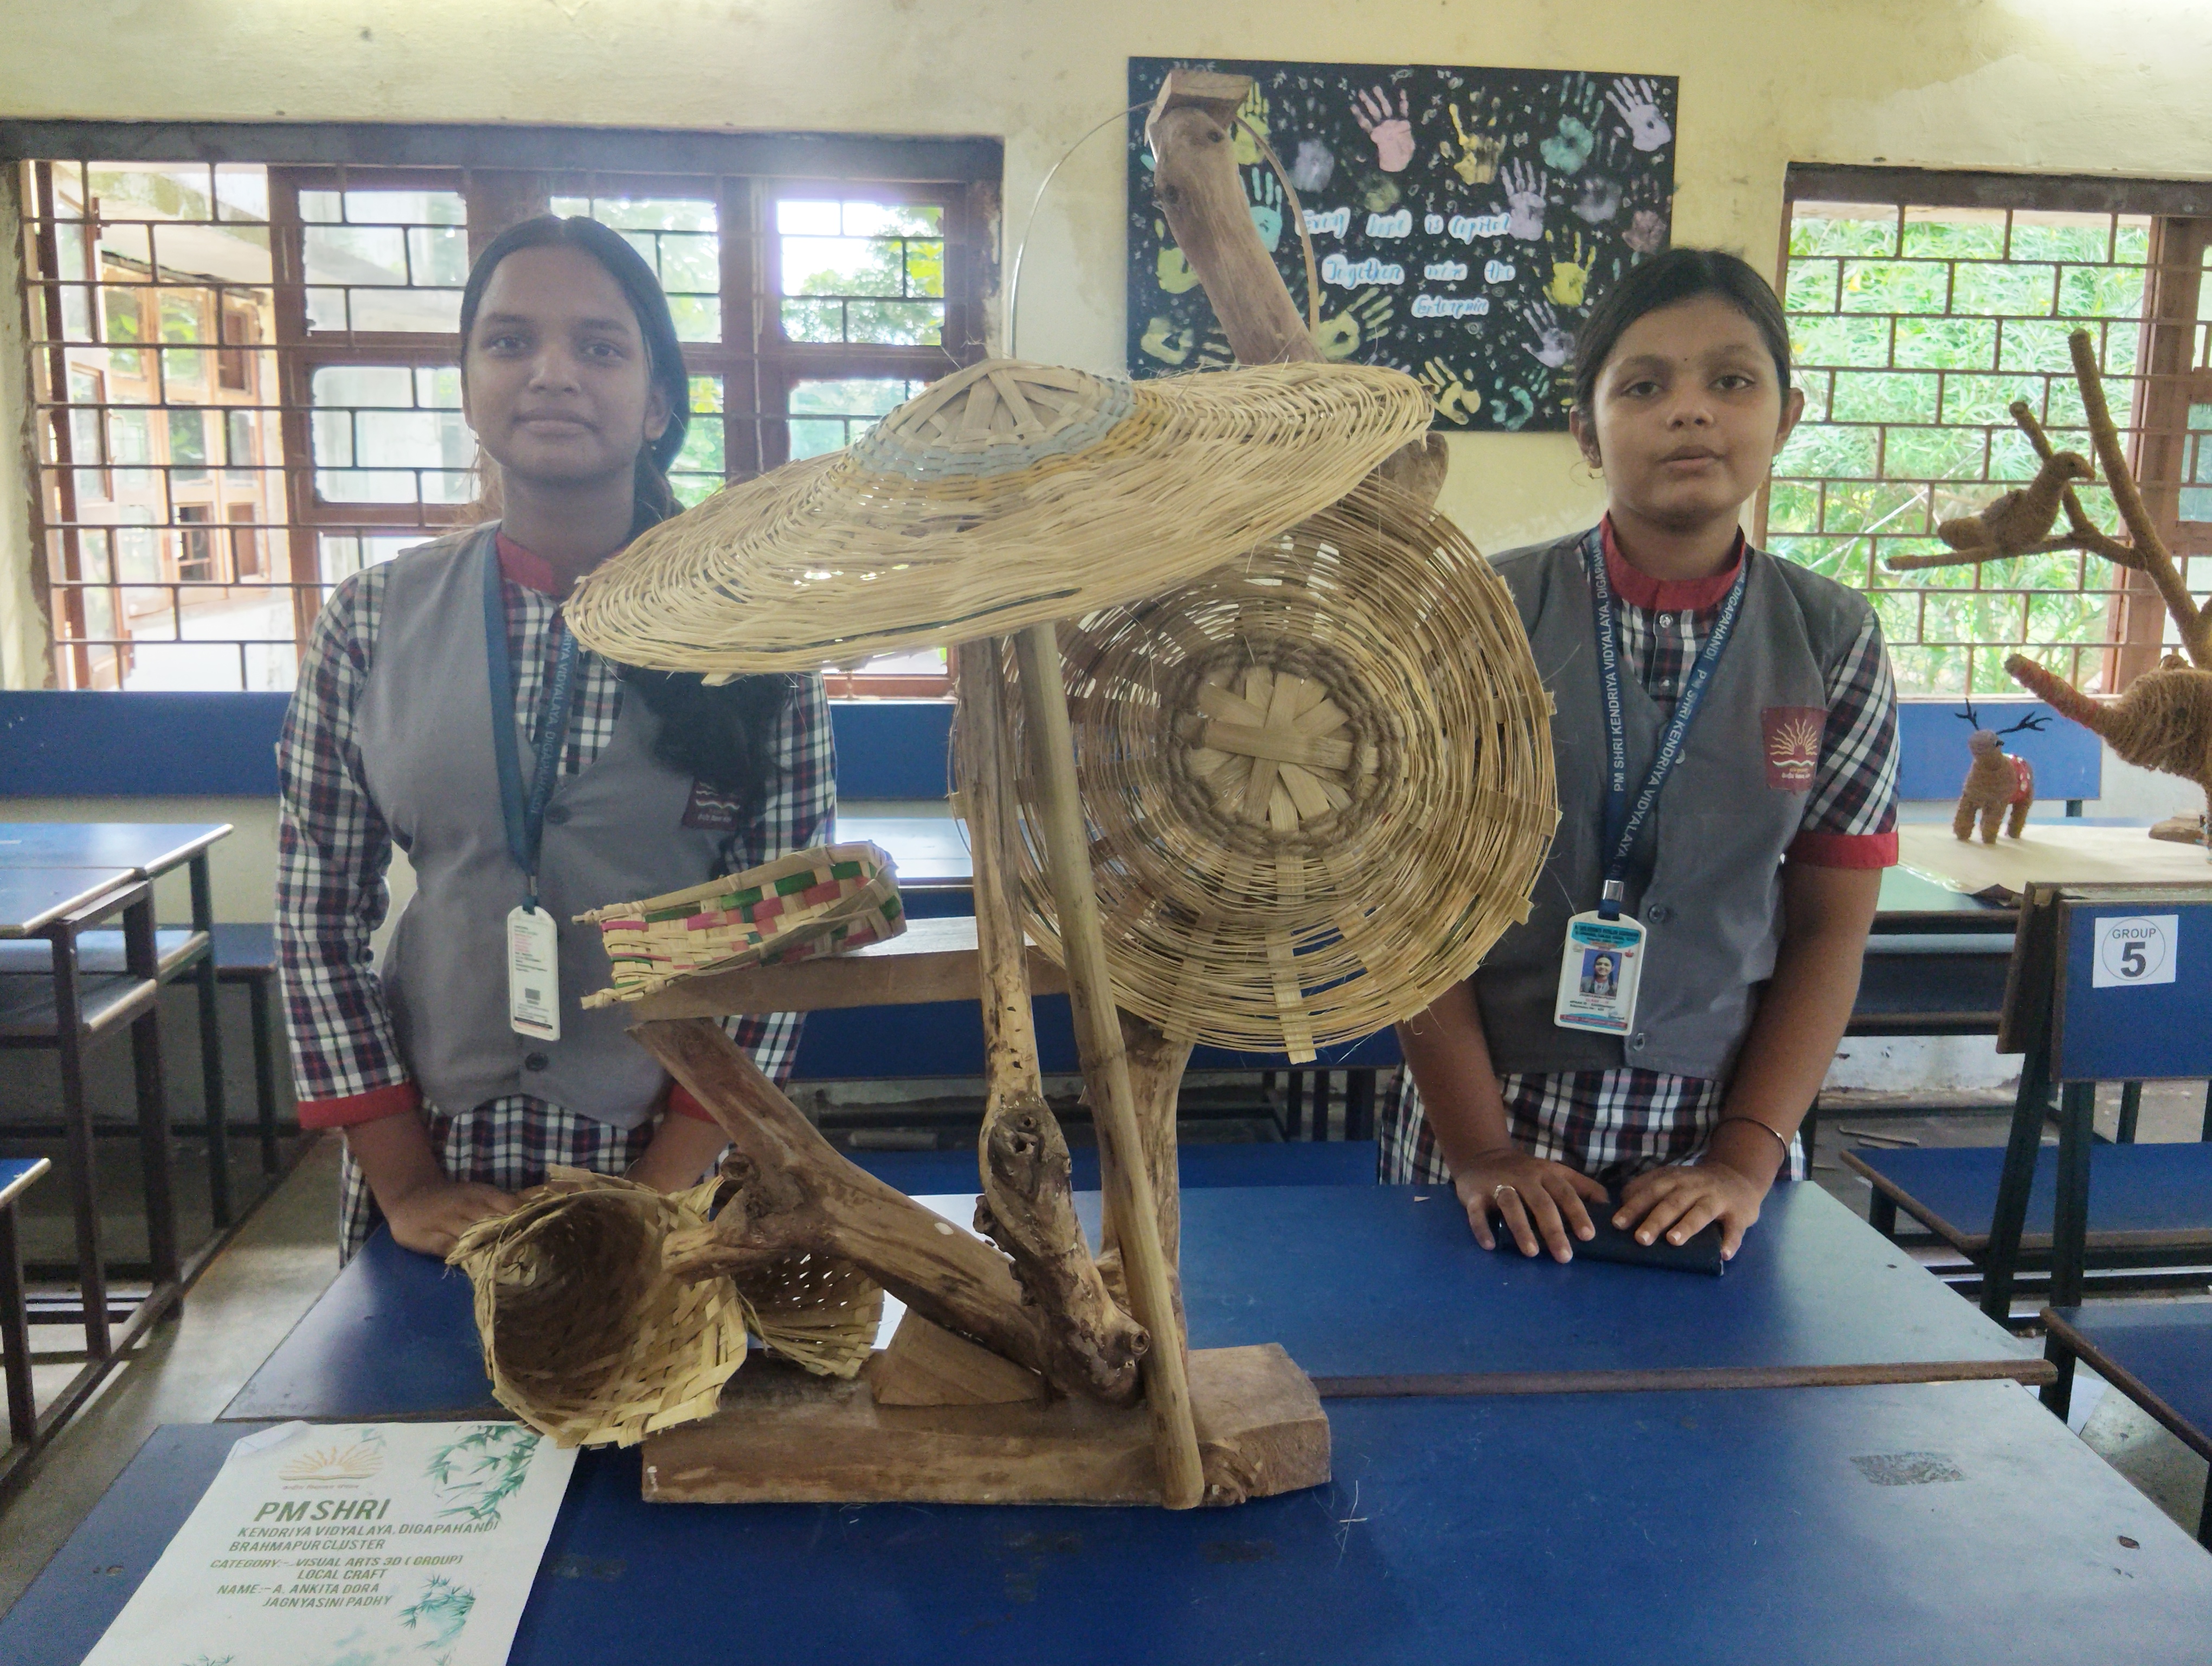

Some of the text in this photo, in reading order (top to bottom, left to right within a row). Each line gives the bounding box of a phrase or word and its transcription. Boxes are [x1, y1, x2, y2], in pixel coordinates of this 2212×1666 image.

[1425, 215, 1442, 234] is
[1324, 257, 1402, 289] Together
[1592, 534, 1608, 598] DIGAPAH
[1704, 586, 1741, 661] DIGAPAHANDI
[561, 627, 573, 661] DRIYA
[1605, 672, 1623, 735] KENDRIYA
[1679, 690, 1699, 720] SHRI
[1612, 738, 1624, 768] SHRI
[1648, 720, 1686, 785] KENDRIYA
[1613, 773, 1624, 792] PM
[2112, 928, 2157, 939] GROUP
[2120, 941, 2147, 977] 5
[253, 1498, 391, 1522] PM SHRI
[237, 1527, 312, 1537] KENDRIYA
[398, 1521, 498, 1534] DIGAPAHANDI
[228, 1539, 386, 1552] BRAHMAPUR CLUSTER
[296, 1558, 341, 1567] VISUAL
[345, 1557, 381, 1567] ARTS
[383, 1556, 402, 1566] 3D
[297, 1568, 388, 1580] LOCAL CRAFT
[288, 1584, 339, 1594] ANKITA
[342, 1583, 380, 1594] DORA
[262, 1595, 393, 1608] JAGNYASINI PADHY
